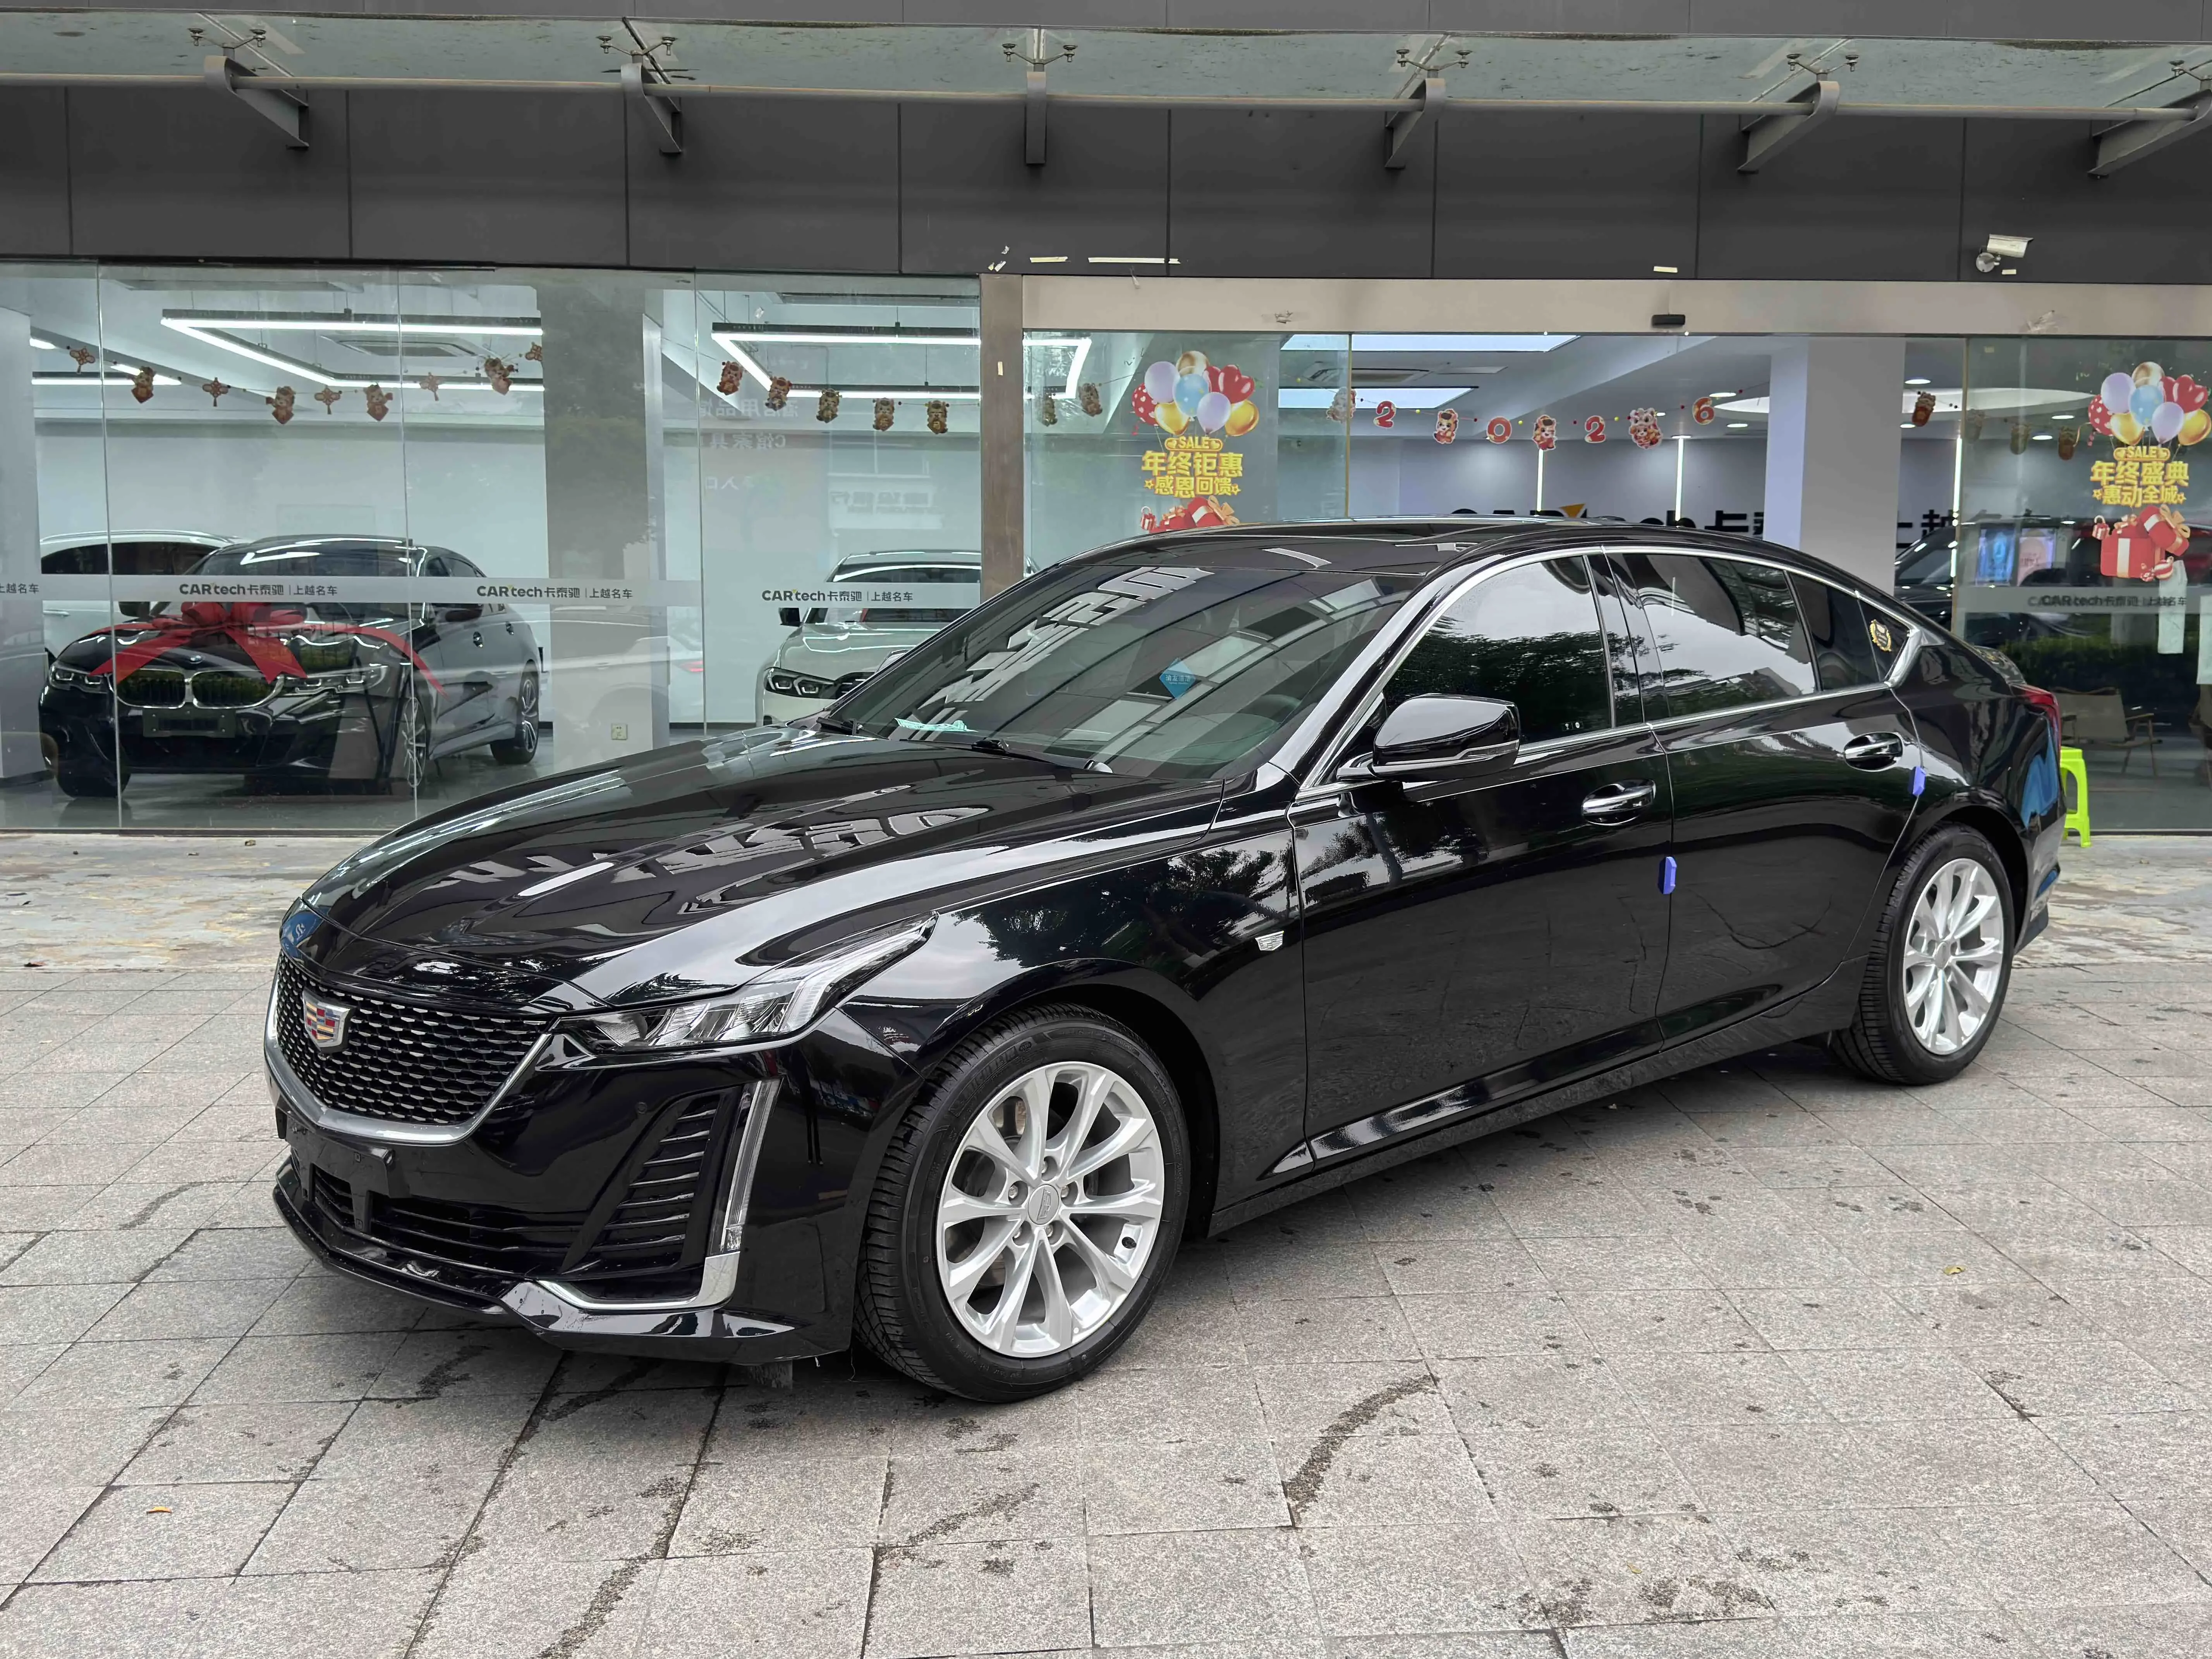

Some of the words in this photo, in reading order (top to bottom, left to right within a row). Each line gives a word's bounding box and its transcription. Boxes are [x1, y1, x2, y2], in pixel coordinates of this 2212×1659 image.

[1374, 400, 1396, 428] 2
[1585, 415, 1606, 443] 2
[1692, 397, 1715, 425] 6
[1178, 436, 1209, 449] SALE
[2126, 446, 2157, 458] SALE
[1141, 450, 1243, 477] 年终钜惠
[2090, 460, 2189, 486] 年终盛典
[1154, 475, 1232, 498] 感恩回馈
[2102, 485, 2178, 507] 惠动全城
[294, 585, 338, 596] 上越名车
[589, 588, 633, 599] 上越名车
[871, 591, 913, 602] 上越名车
